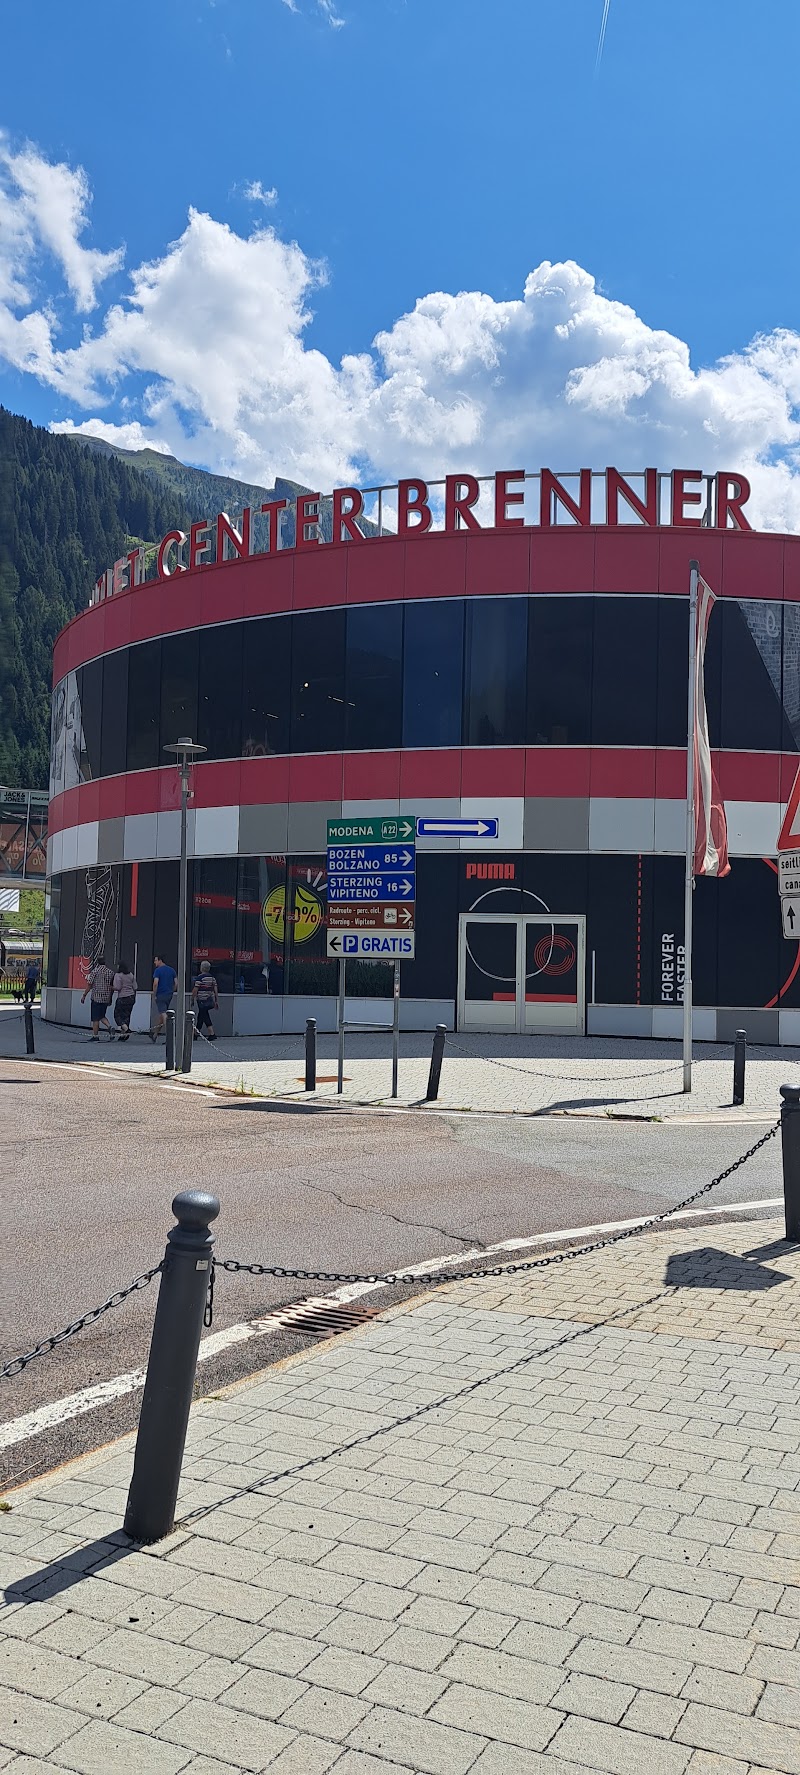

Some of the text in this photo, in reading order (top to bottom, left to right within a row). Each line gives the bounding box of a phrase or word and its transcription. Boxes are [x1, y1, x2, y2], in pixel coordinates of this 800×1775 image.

[157, 487, 366, 577] CENTER
[398, 467, 755, 533] BRENNER
[329, 826, 374, 837] MODENA
[329, 849, 365, 859] BOZEN
[329, 854, 398, 870] BOLZANO 85
[466, 863, 515, 879] PUMA
[330, 877, 382, 887] STERZING
[330, 882, 398, 898] VIPITENO 16
[361, 937, 412, 952] GRATIS
[661, 933, 674, 1001] FOREVER
